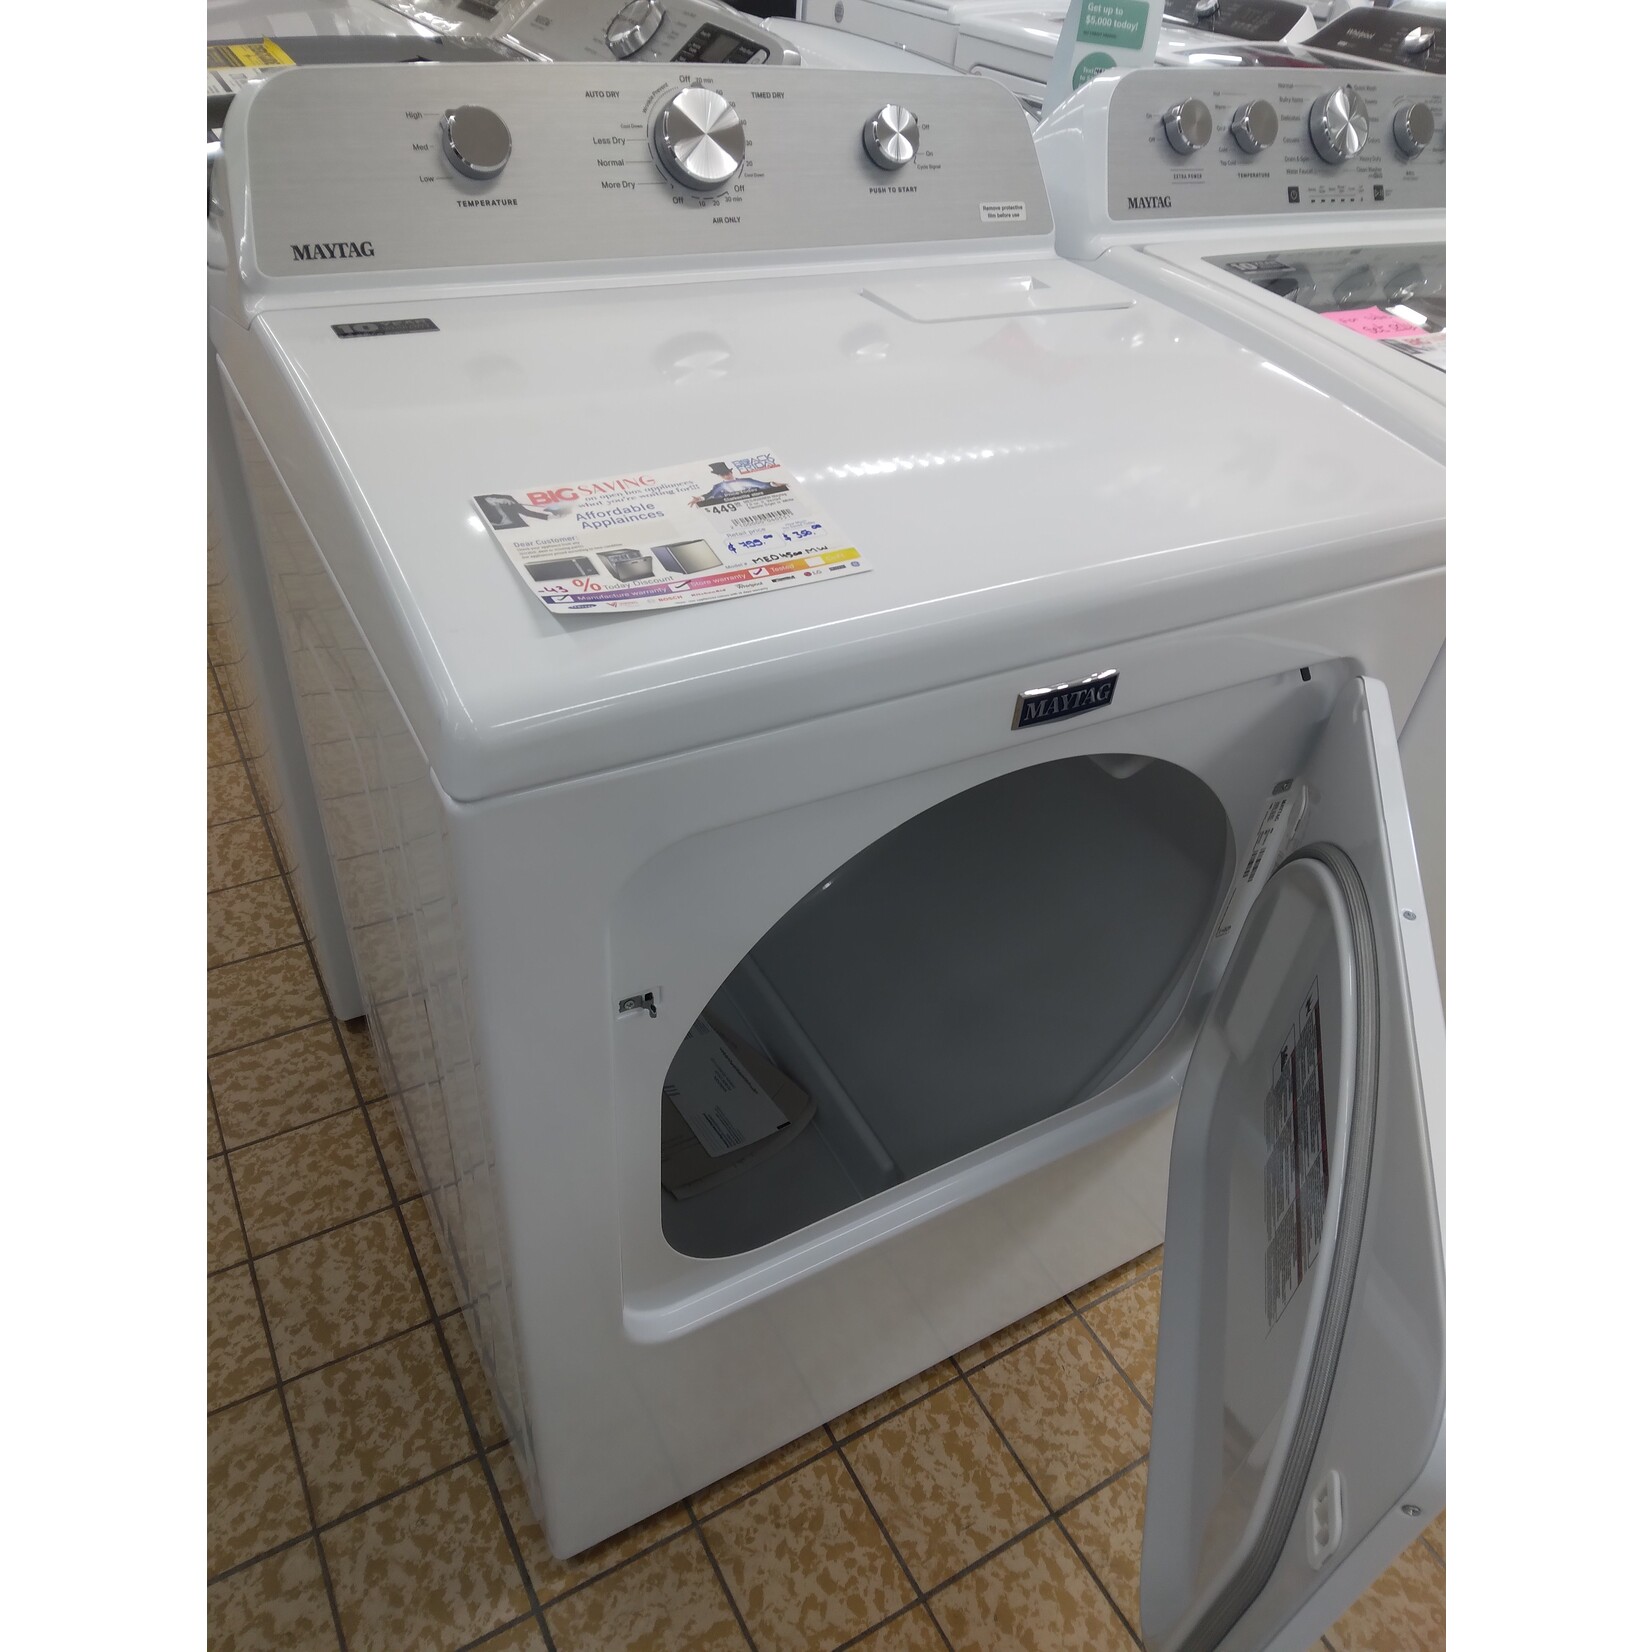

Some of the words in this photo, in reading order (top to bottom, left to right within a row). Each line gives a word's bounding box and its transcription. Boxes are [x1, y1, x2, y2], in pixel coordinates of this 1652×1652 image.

[1087, 2, 1102, 12] Get
[1103, 6, 1113, 16] up
[1115, 7, 1124, 16] to
[1086, 14, 1112, 26] $5,000
[1113, 17, 1139, 32] today!
[679, 75, 691, 83] Off
[585, 91, 605, 99] AUTO
[606, 91, 620, 99] DRY
[651, 82, 669, 97] Prevent
[751, 91, 770, 99] TIMED
[772, 91, 785, 99] DRY
[405, 112, 423, 120] High
[593, 137, 610, 145] Less
[611, 137, 626, 146] Dry
[597, 159, 625, 167] Normal
[602, 181, 620, 189] More
[621, 181, 636, 190] Dry
[734, 185, 745, 193] Off
[898, 186, 918, 194] START
[456, 198, 518, 208] TEMPERATURE
[672, 196, 684, 205] Off
[1128, 196, 1172, 209] MAYTAG
[713, 217, 723, 225] AIR
[724, 216, 741, 224] ONLY
[290, 241, 375, 261] MAYTAG
[527, 487, 580, 506] BIG
[577, 476, 656, 496] SAVING
[585, 495, 597, 503] on
[599, 490, 624, 502] open
[625, 487, 643, 497] box
[576, 502, 656, 522] Affordable
[581, 510, 665, 530] Applainces
[726, 530, 747, 538] Retail
[748, 527, 767, 536] price
[513, 540, 534, 548] Dear
[535, 535, 579, 546] Customer:
[771, 563, 795, 573] Tested
[572, 577, 602, 593] %
[604, 581, 631, 591] Today
[632, 575, 674, 587] Discount
[690, 578, 713, 588] Store
[714, 573, 747, 585] warranty
[577, 591, 630, 602] Manufacture
[632, 587, 668, 598] warranty
[657, 595, 683, 603] BOSCH
[1024, 683, 1111, 720] MAYTAG
